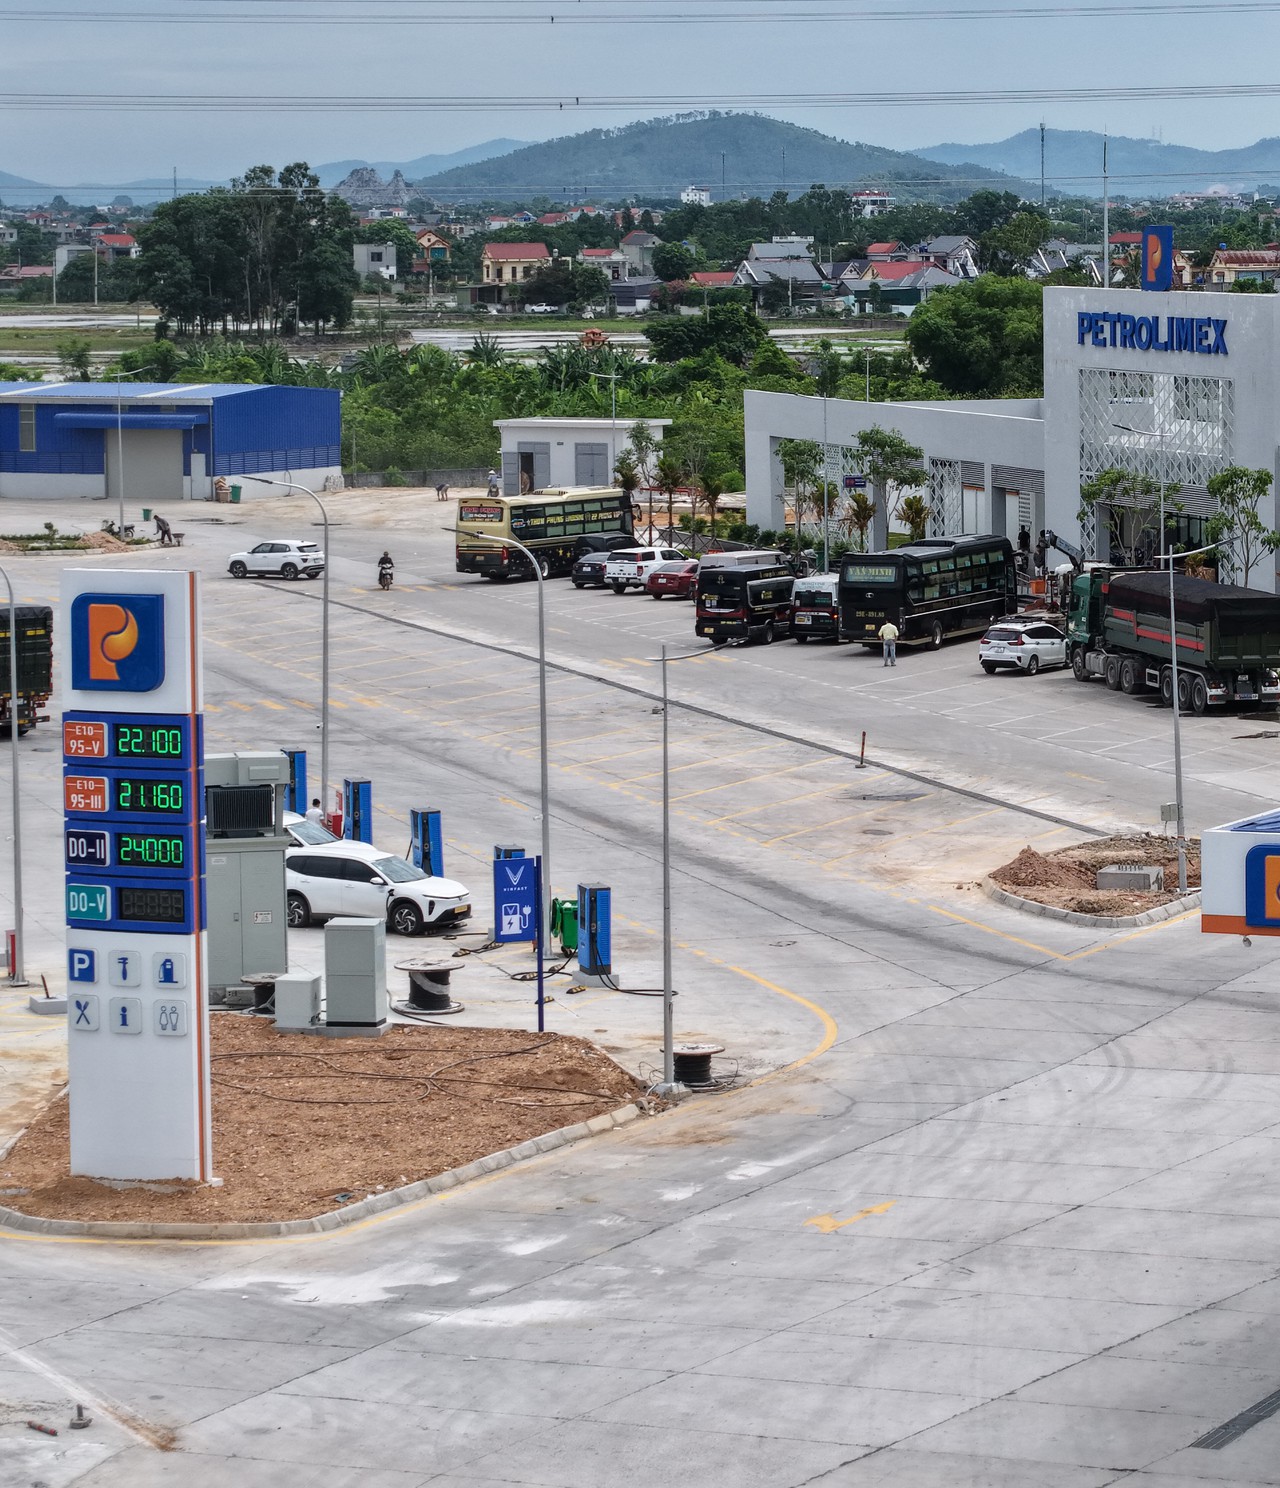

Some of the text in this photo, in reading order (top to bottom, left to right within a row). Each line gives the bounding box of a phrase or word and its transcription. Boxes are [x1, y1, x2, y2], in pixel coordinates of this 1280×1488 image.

[1077, 311, 1229, 355] PETROLIMEX
[75, 725, 94, 736] E10
[118, 728, 181, 754] 22.100
[69, 739, 100, 754] 95-V
[76, 780, 95, 790] E10
[70, 794, 102, 809] 95-III
[119, 783, 182, 809] 21.160
[69, 838, 105, 859] DO-II
[120, 838, 183, 864] 24.000
[69, 892, 105, 913] DO-V
[73, 952, 90, 978] P
